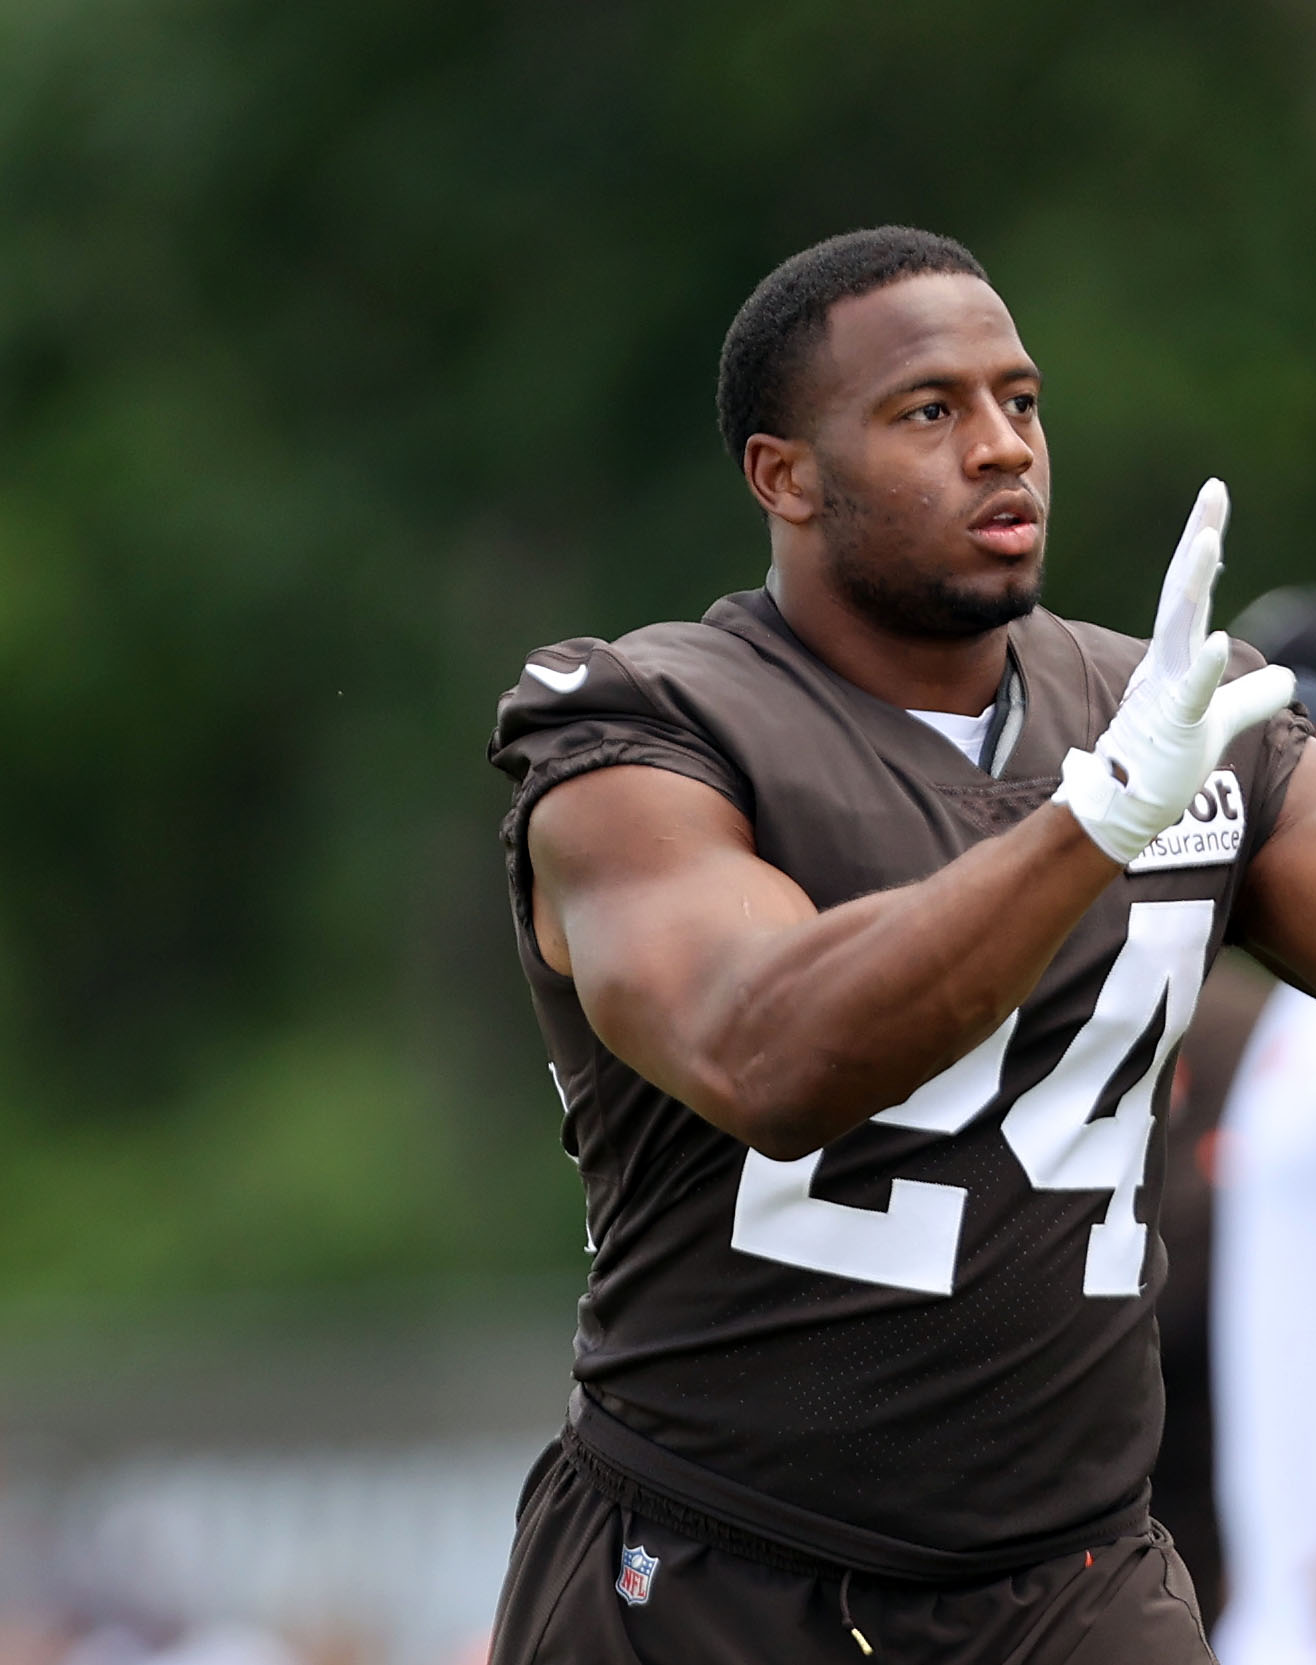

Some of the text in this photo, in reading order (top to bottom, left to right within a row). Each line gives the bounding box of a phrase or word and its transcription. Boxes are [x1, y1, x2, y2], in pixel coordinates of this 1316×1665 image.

[1173, 780, 1238, 822] ot
[1142, 830, 1240, 857] nsurance
[622, 1567, 646, 1597] NFL
